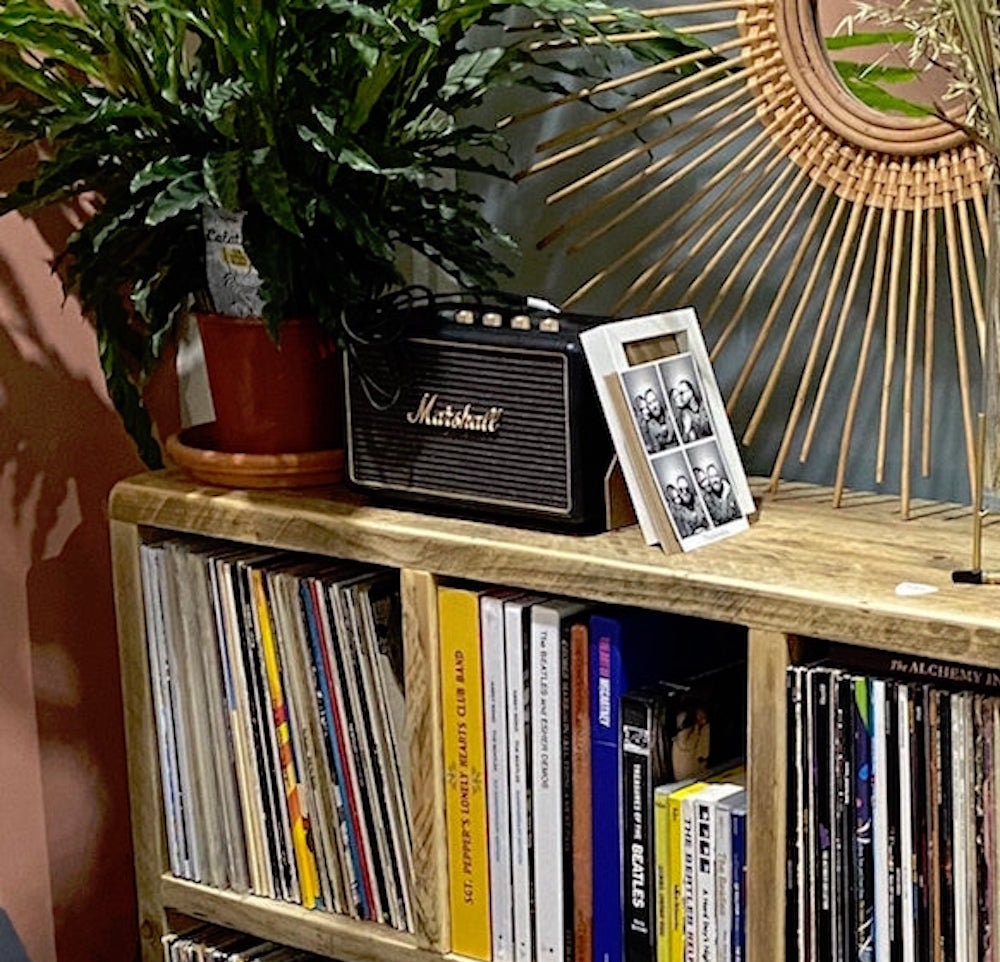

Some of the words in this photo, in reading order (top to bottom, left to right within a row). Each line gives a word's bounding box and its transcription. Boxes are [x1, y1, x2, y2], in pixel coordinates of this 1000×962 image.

[406, 392, 504, 433] Marshall
[539, 631, 548, 649] The
[453, 650, 465, 683] BAND
[539, 650, 548, 695] BEATLES
[890, 659, 908, 673] The
[909, 661, 982, 684] ALCHEMY
[455, 687, 466, 718] CLUB
[456, 722, 468, 767] HEARTS
[540, 717, 549, 752] ESHER
[540, 753, 550, 790] DEMOS
[458, 771, 471, 815] LONELY
[461, 818, 473, 875] PEPPER'S
[684, 817, 693, 848] THE
[463, 879, 474, 905] SGT.
[631, 843, 645, 909] BEATLES
